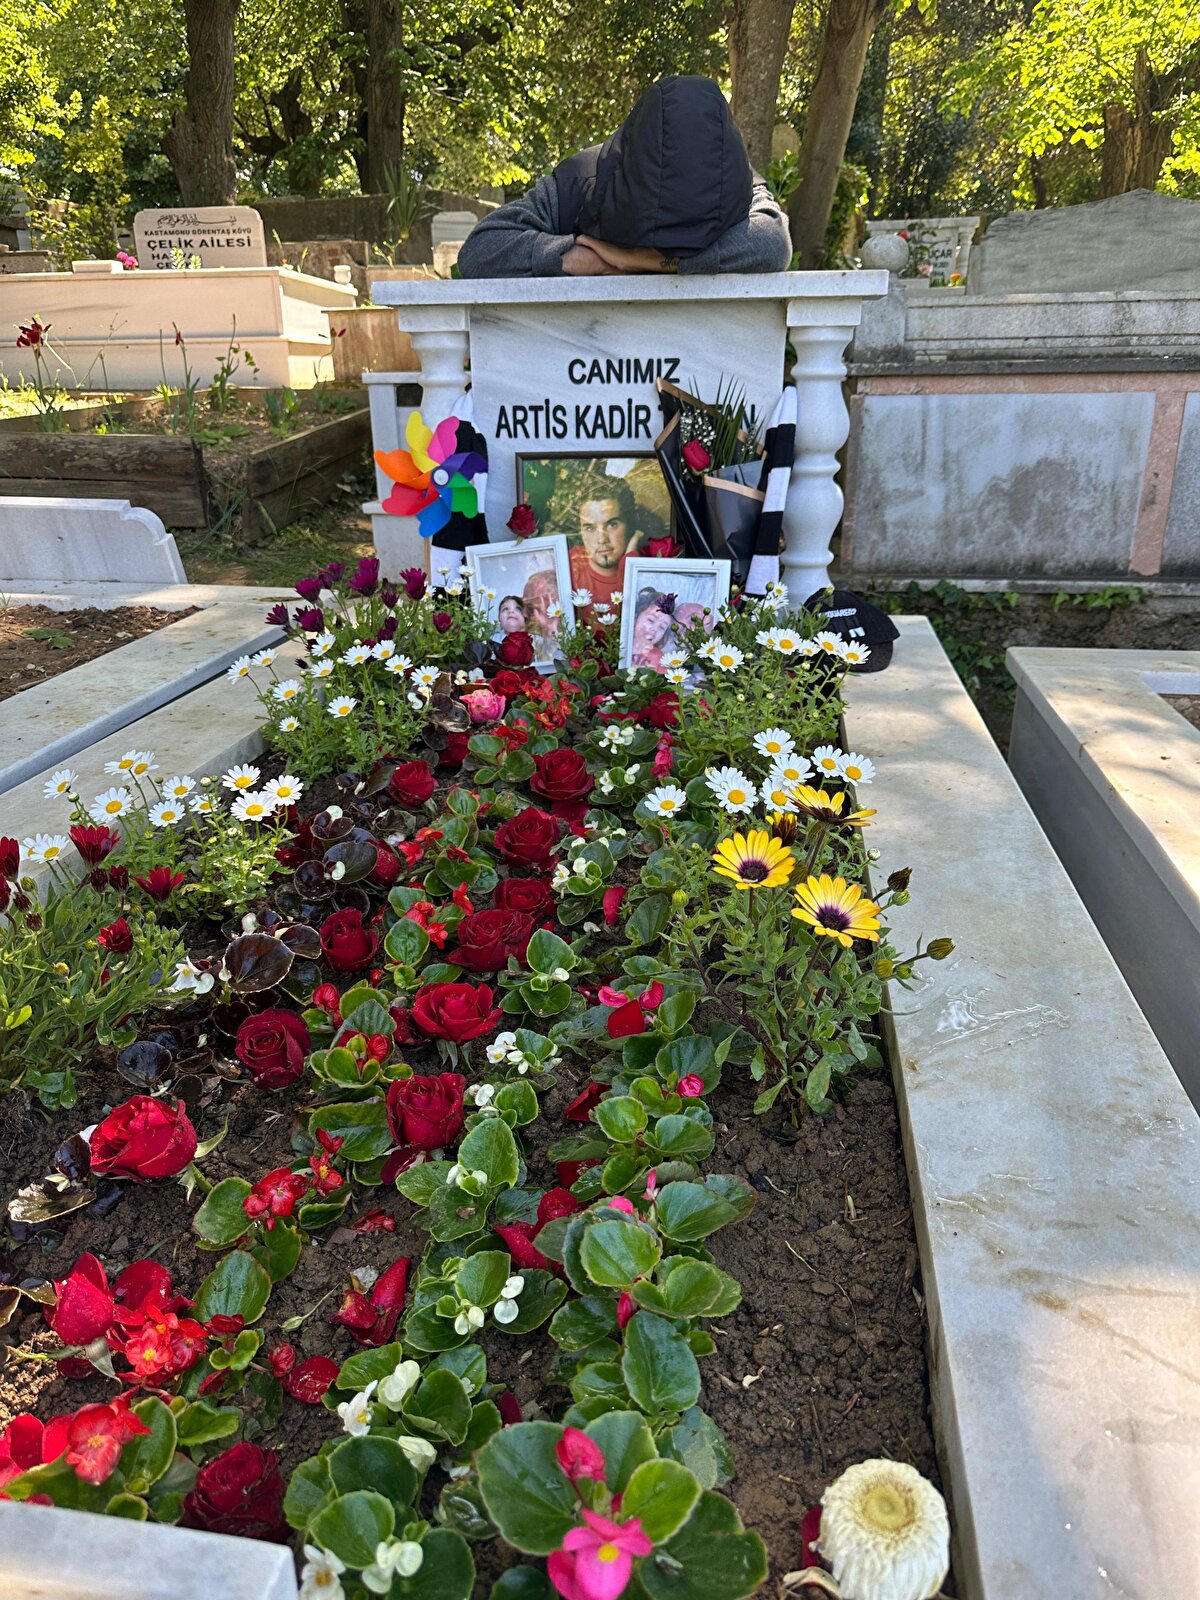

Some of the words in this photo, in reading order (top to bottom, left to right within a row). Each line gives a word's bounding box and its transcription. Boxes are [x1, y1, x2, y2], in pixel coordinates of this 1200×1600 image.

[192, 228, 231, 236] GÖRENTAŞ
[147, 237, 194, 250] ÇELİK
[199, 236, 251, 248] AİLESİ
[568, 358, 680, 385] CANIMIZ
[495, 398, 568, 439] ARTİS
[575, 398, 652, 439] KADİR
